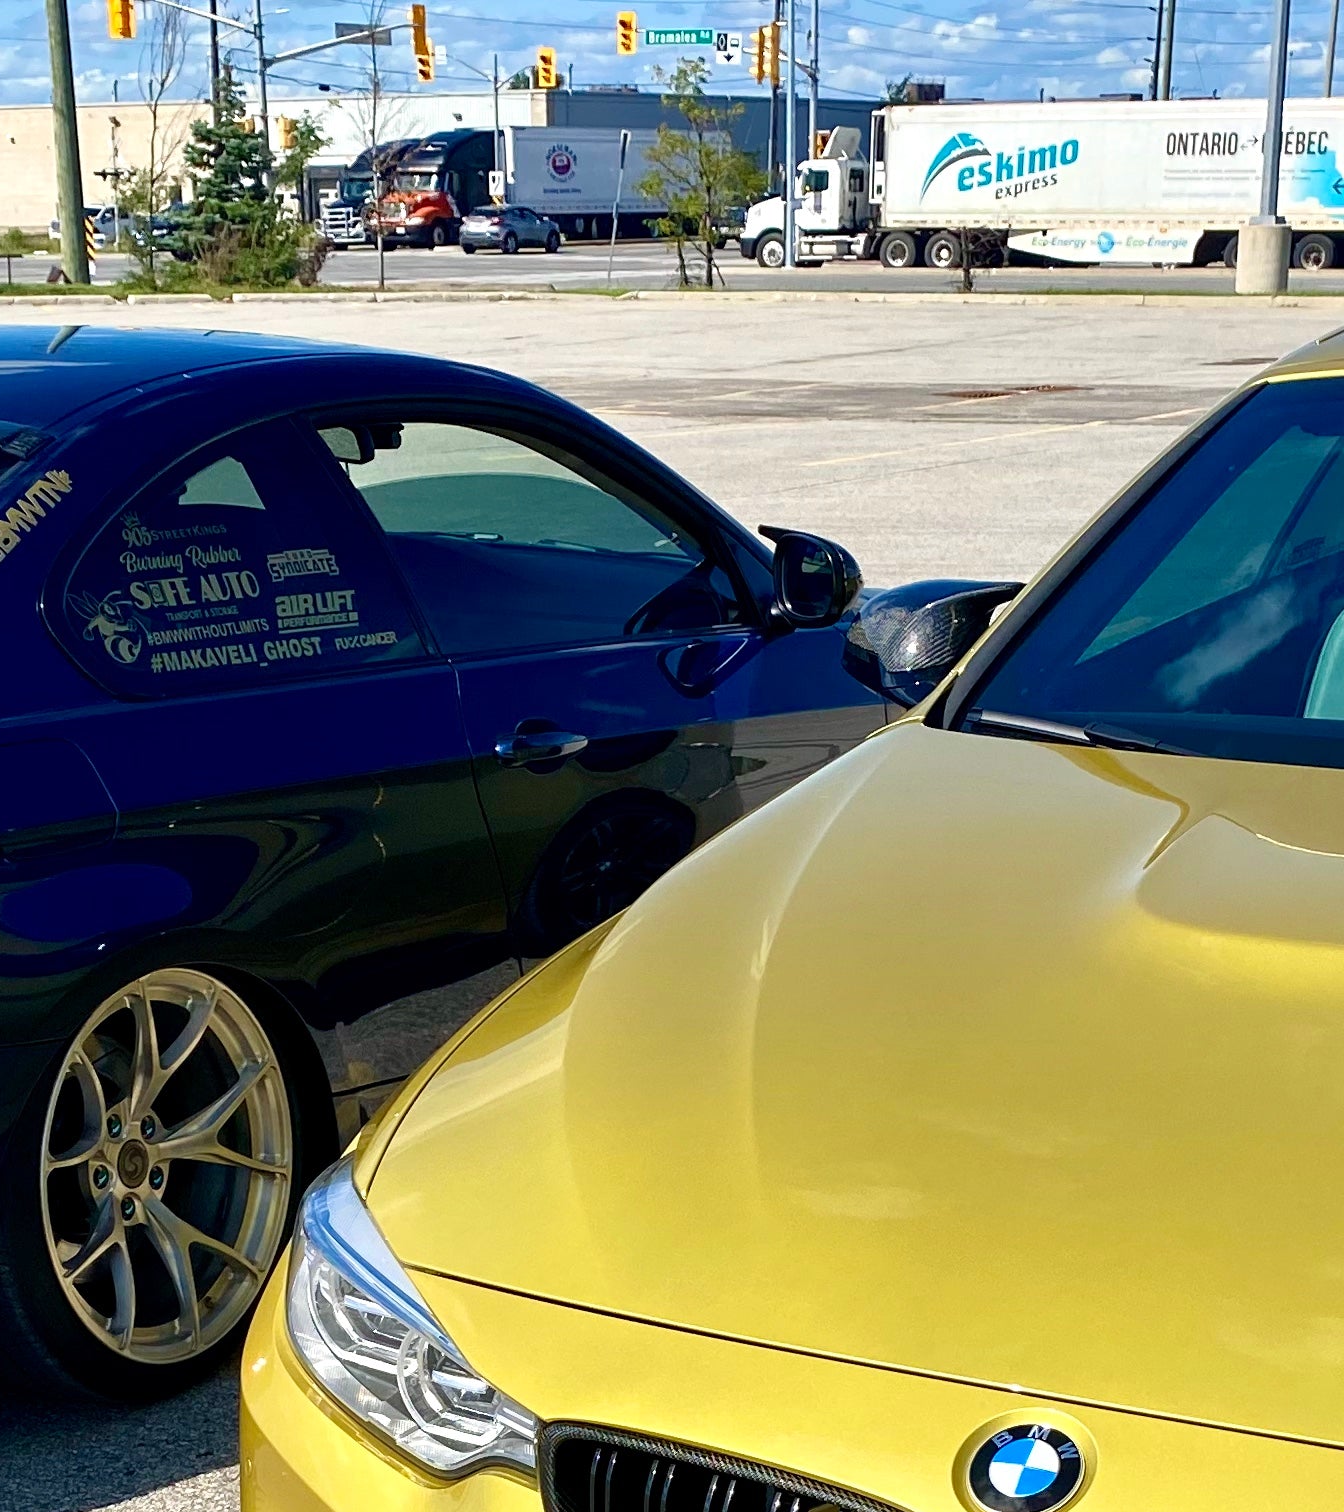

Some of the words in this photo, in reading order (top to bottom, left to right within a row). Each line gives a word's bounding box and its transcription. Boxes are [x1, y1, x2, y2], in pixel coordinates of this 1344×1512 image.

[648, 31, 697, 44] Bramalea
[1166, 131, 1239, 156] ONTARIO
[957, 139, 1079, 192] eskimo
[995, 173, 1058, 200] express
[120, 551, 184, 574] Burning
[185, 545, 241, 568] Rubber
[268, 556, 339, 581] SYNDICATE
[200, 570, 260, 602] AUTO
[150, 636, 322, 673] #MAKAVELI_GHOST
[992, 1424, 1080, 1460] BMW
